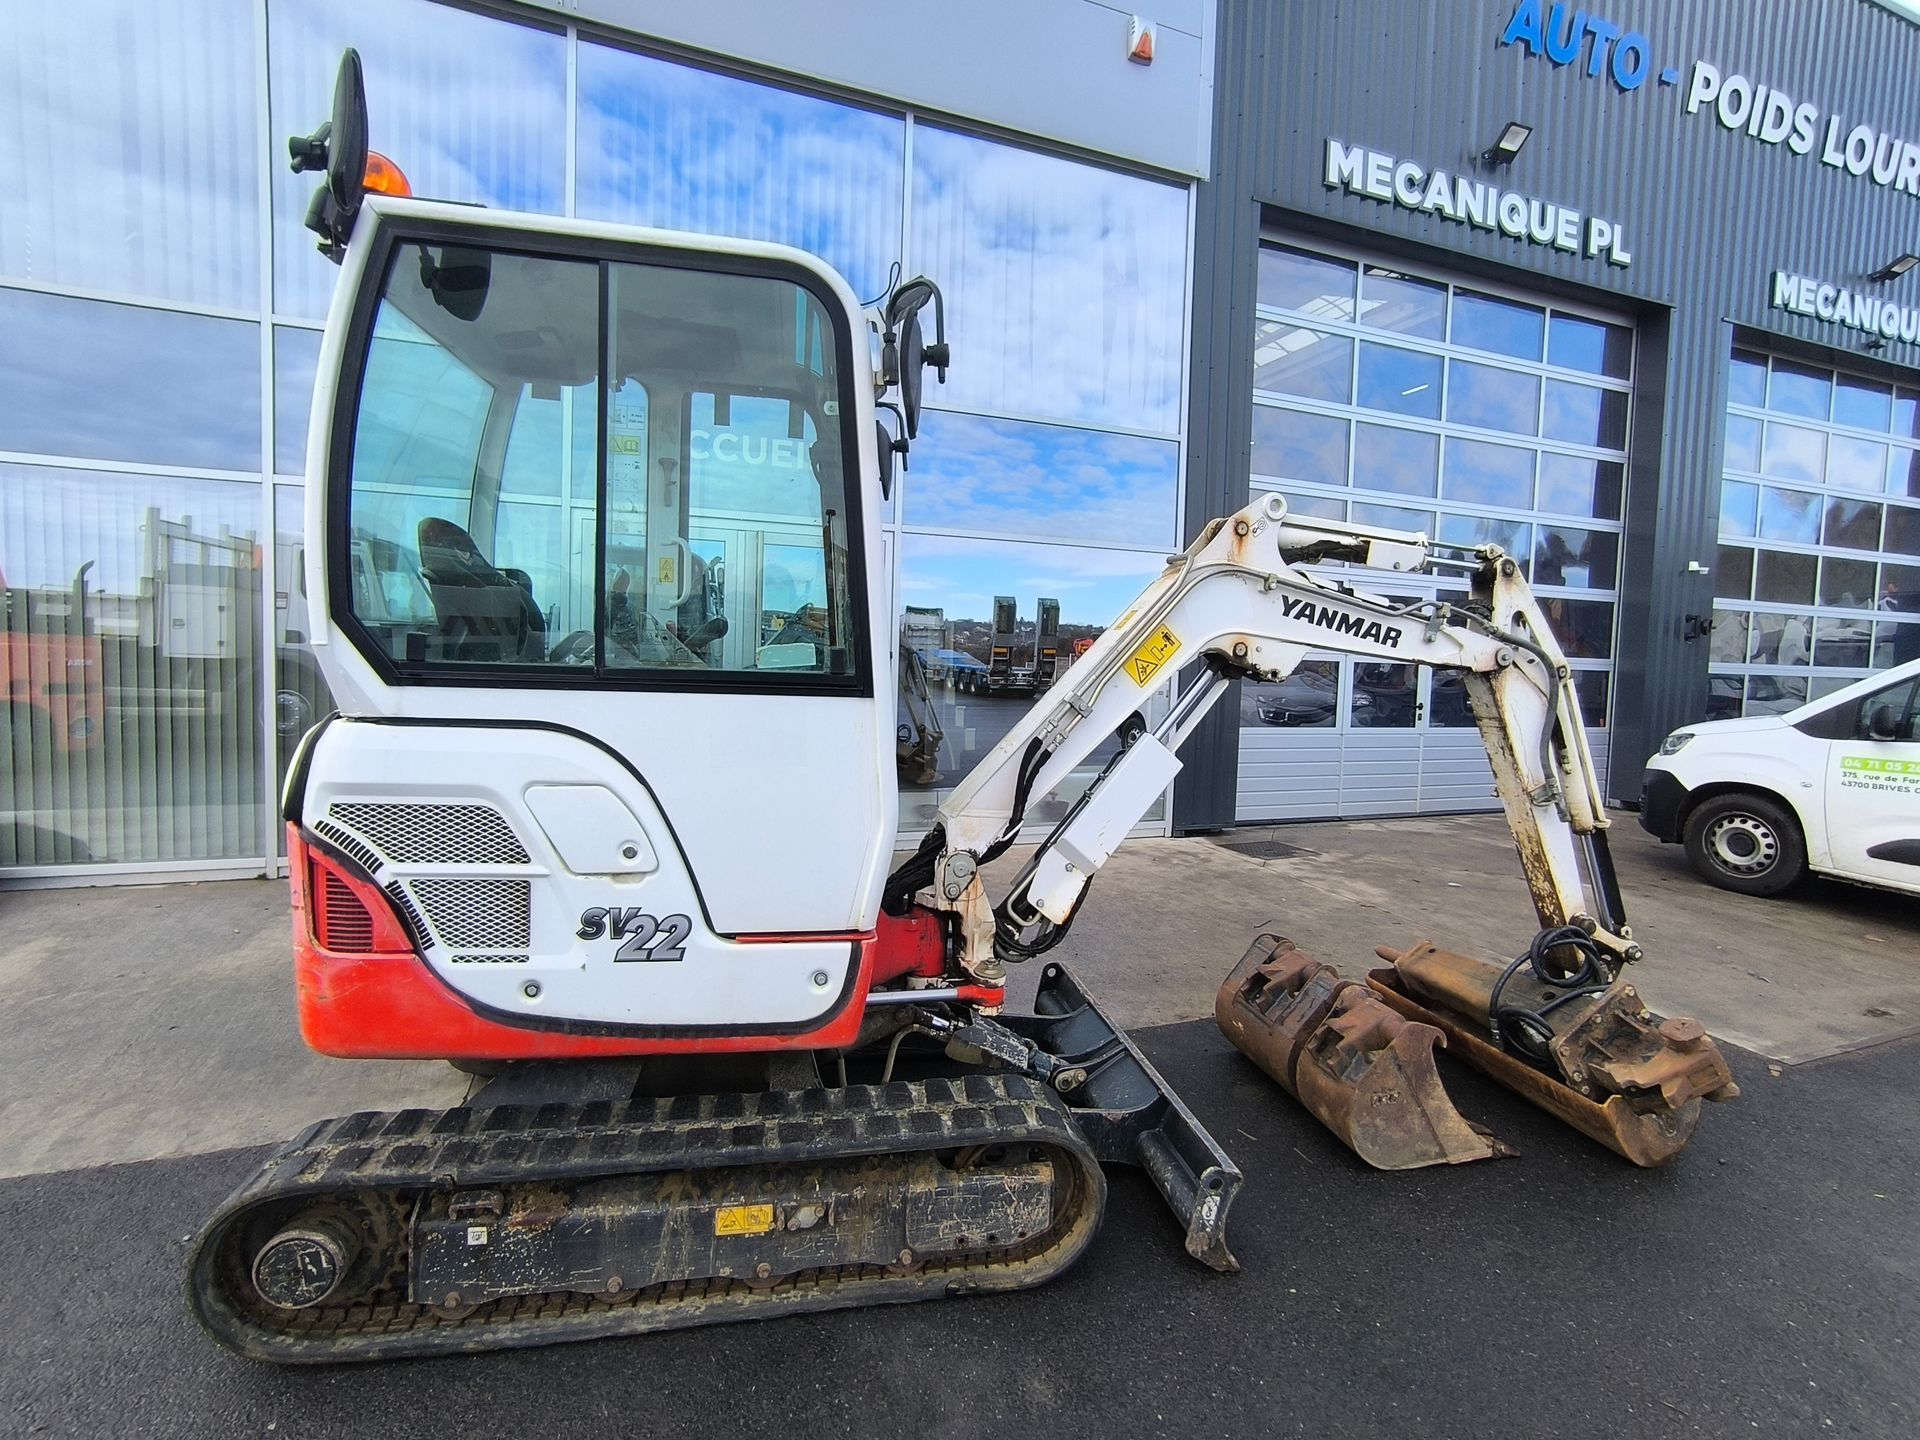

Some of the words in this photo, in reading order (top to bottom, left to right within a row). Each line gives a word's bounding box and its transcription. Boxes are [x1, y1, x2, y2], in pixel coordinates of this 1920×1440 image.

[1503, 0, 1651, 90] AUTO
[1687, 60, 1818, 155] POIDS
[1823, 113, 1920, 197] LOUR
[1325, 138, 1581, 252] MECANIQUE
[1588, 215, 1632, 265] PL
[1773, 270, 1920, 346] MECANIQU
[690, 429, 806, 470] CCUEI
[1281, 594, 1403, 649] YANMAR
[1841, 780, 1870, 789] 43700
[1872, 783, 1911, 793] BRIVES
[1844, 758, 1862, 769] 04
[1866, 760, 1880, 770] 71
[1886, 761, 1902, 771] 05
[1884, 775, 1898, 783] de
[576, 906, 693, 963] SV22
